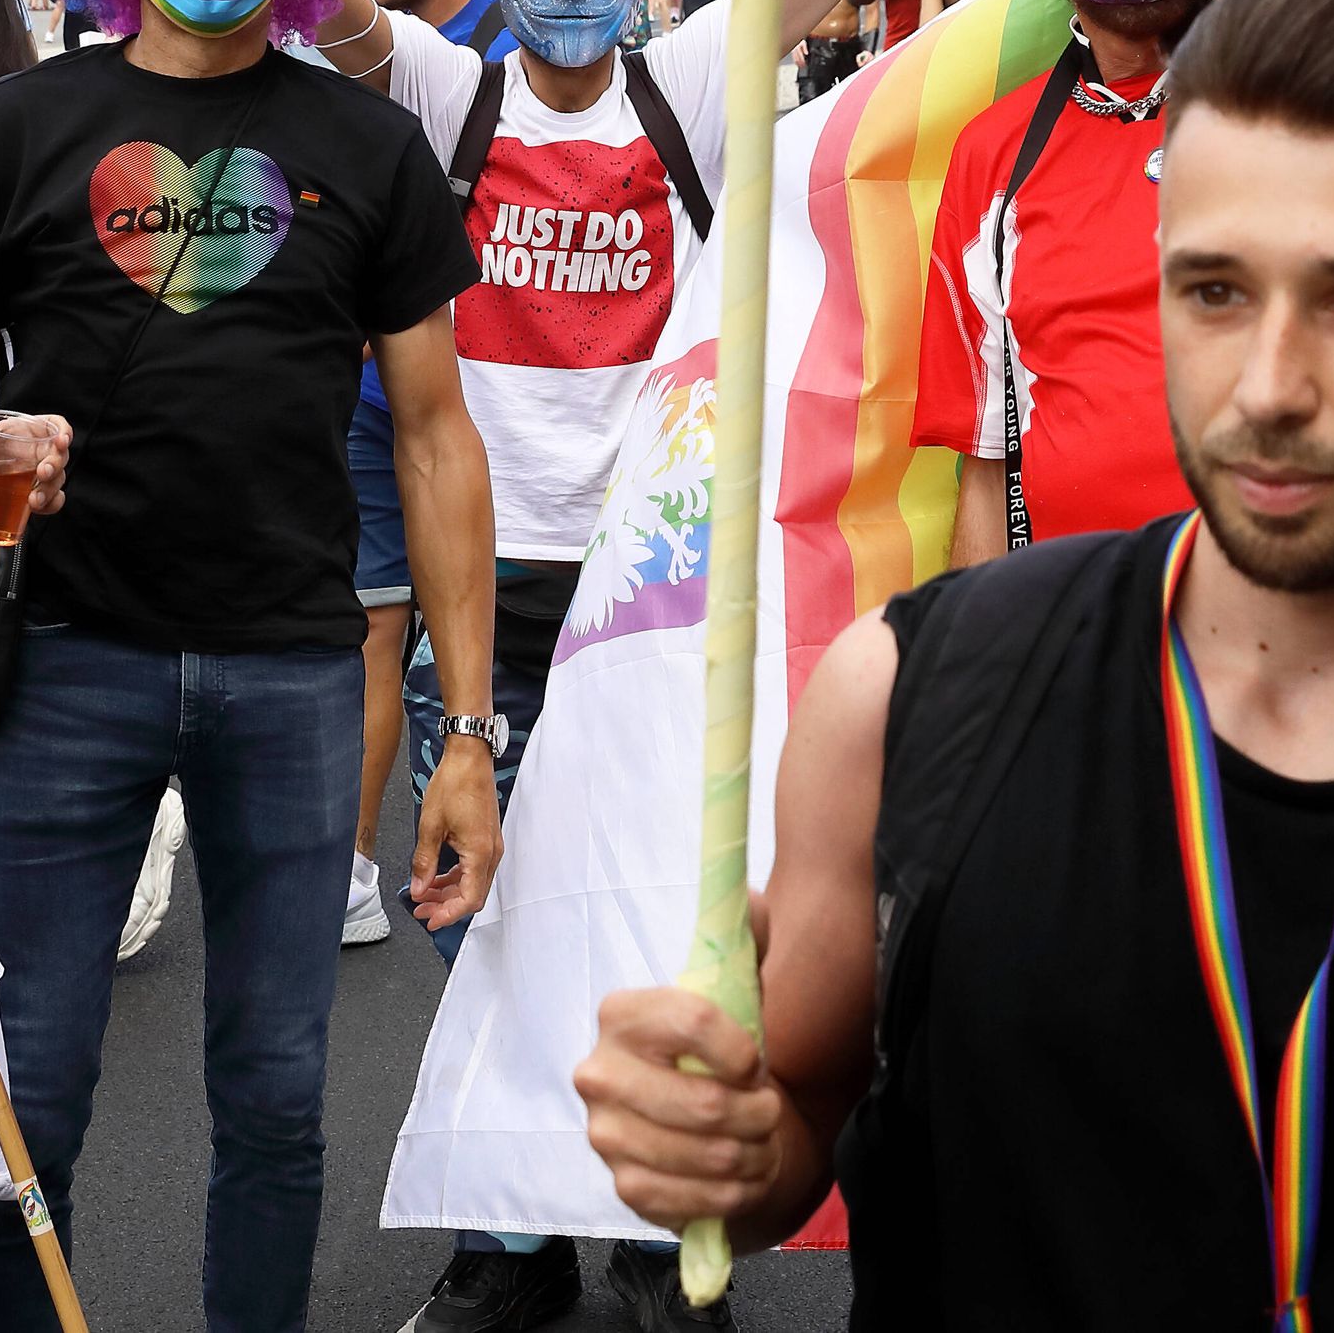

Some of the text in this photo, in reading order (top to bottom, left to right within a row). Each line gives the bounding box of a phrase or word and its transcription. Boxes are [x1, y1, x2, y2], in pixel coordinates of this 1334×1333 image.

[106, 195, 279, 237] adidas
[489, 202, 644, 251] JUST DO
[479, 243, 652, 293] NOTHING
[1006, 384, 1019, 452] YOUNG
